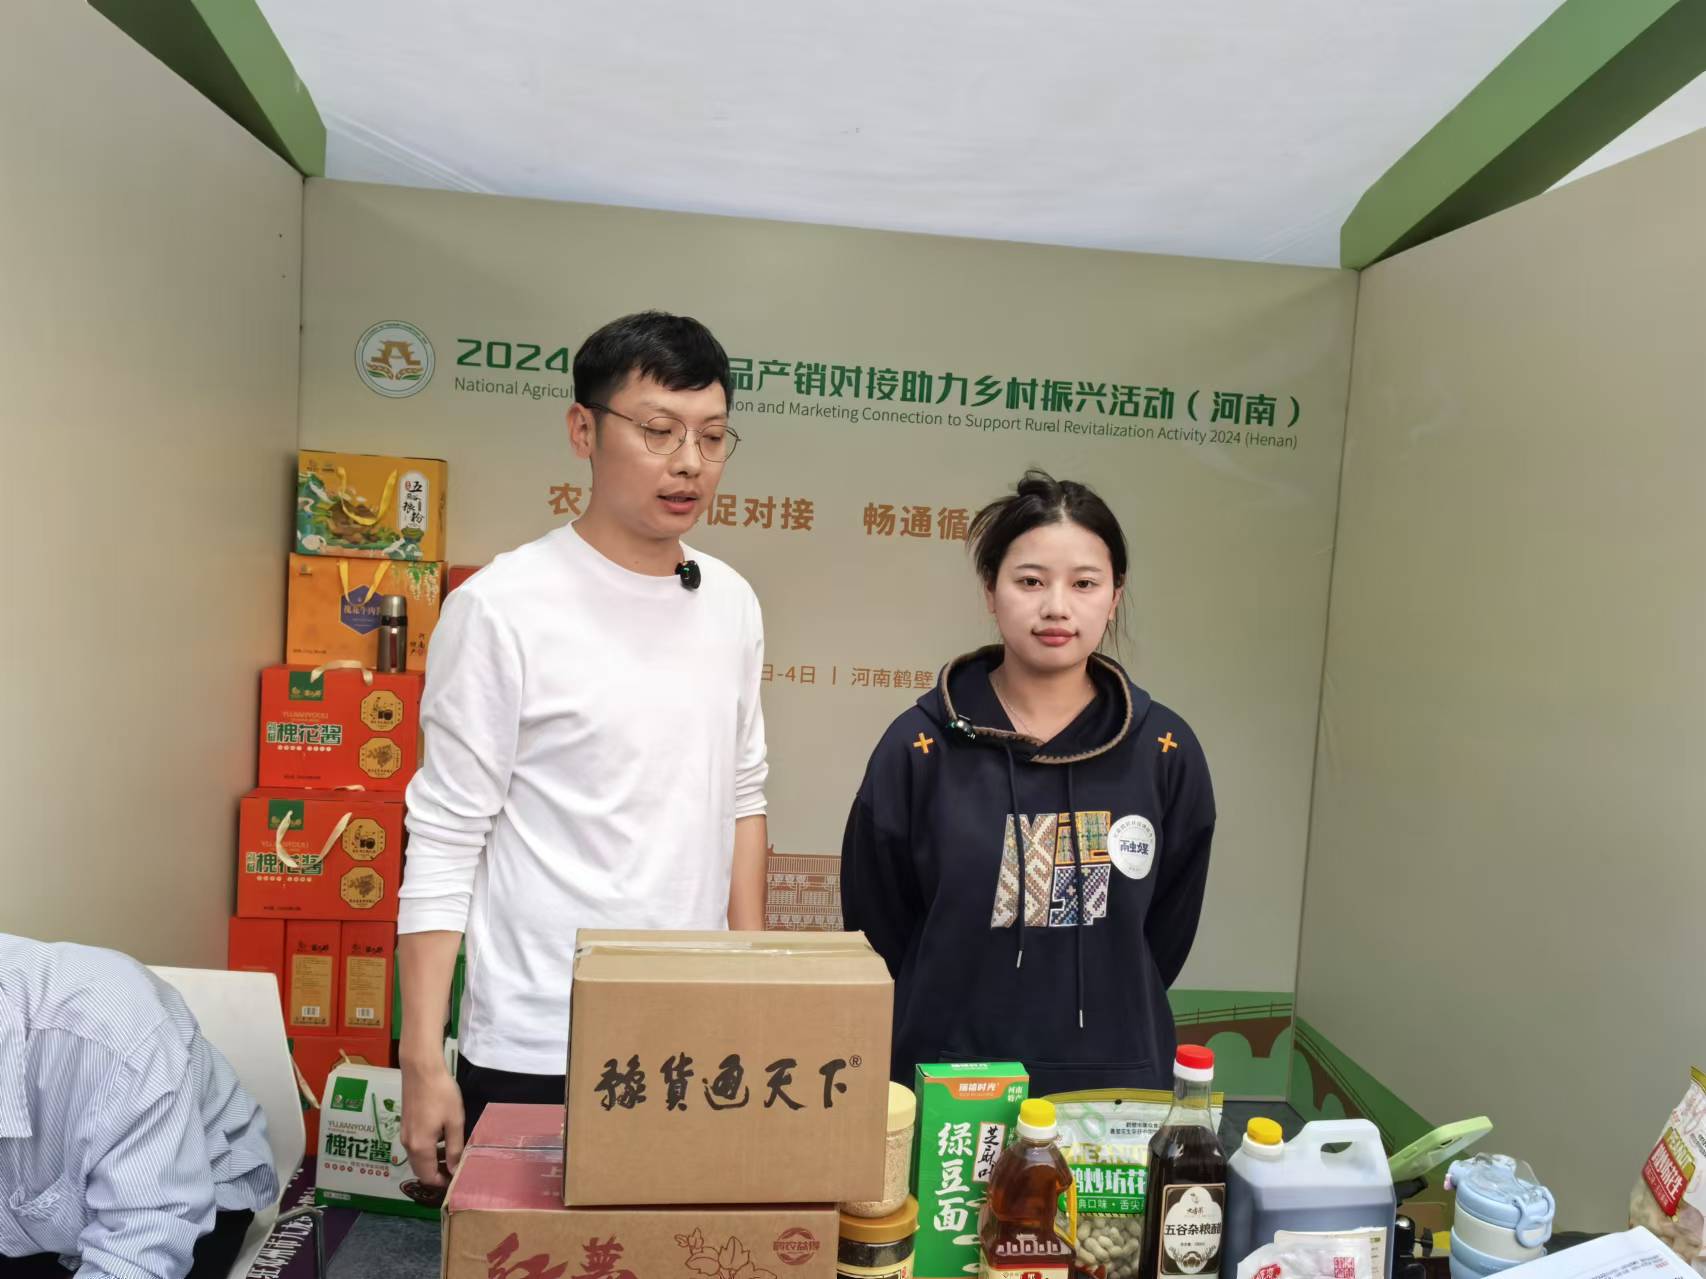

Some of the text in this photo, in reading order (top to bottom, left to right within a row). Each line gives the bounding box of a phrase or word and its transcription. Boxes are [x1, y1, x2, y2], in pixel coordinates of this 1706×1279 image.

[457, 339, 568, 373] 2024
[455, 377, 518, 394] National
[522, 383, 574, 400] Agricul
[758, 401, 784, 414] and
[790, 402, 859, 423] Marketing
[862, 407, 942, 425] Connection
[948, 413, 961, 426] to
[965, 414, 1021, 432] Support
[1025, 418, 1059, 432] Rural
[1064, 420, 1153, 438] Revitalization
[1158, 427, 1206, 444] Activity
[1210, 430, 1241, 443] 2024
[1245, 432, 1298, 450] (Henan)
[548, 483, 970, 541] 农 促对接 畅通循
[851, 667, 934, 689] 河南鹤壁
[325, 1133, 392, 1164] 槐花酱
[933, 1122, 973, 1232] 绿豆面
[1164, 1223, 1221, 1236] 五谷杂粮醋
